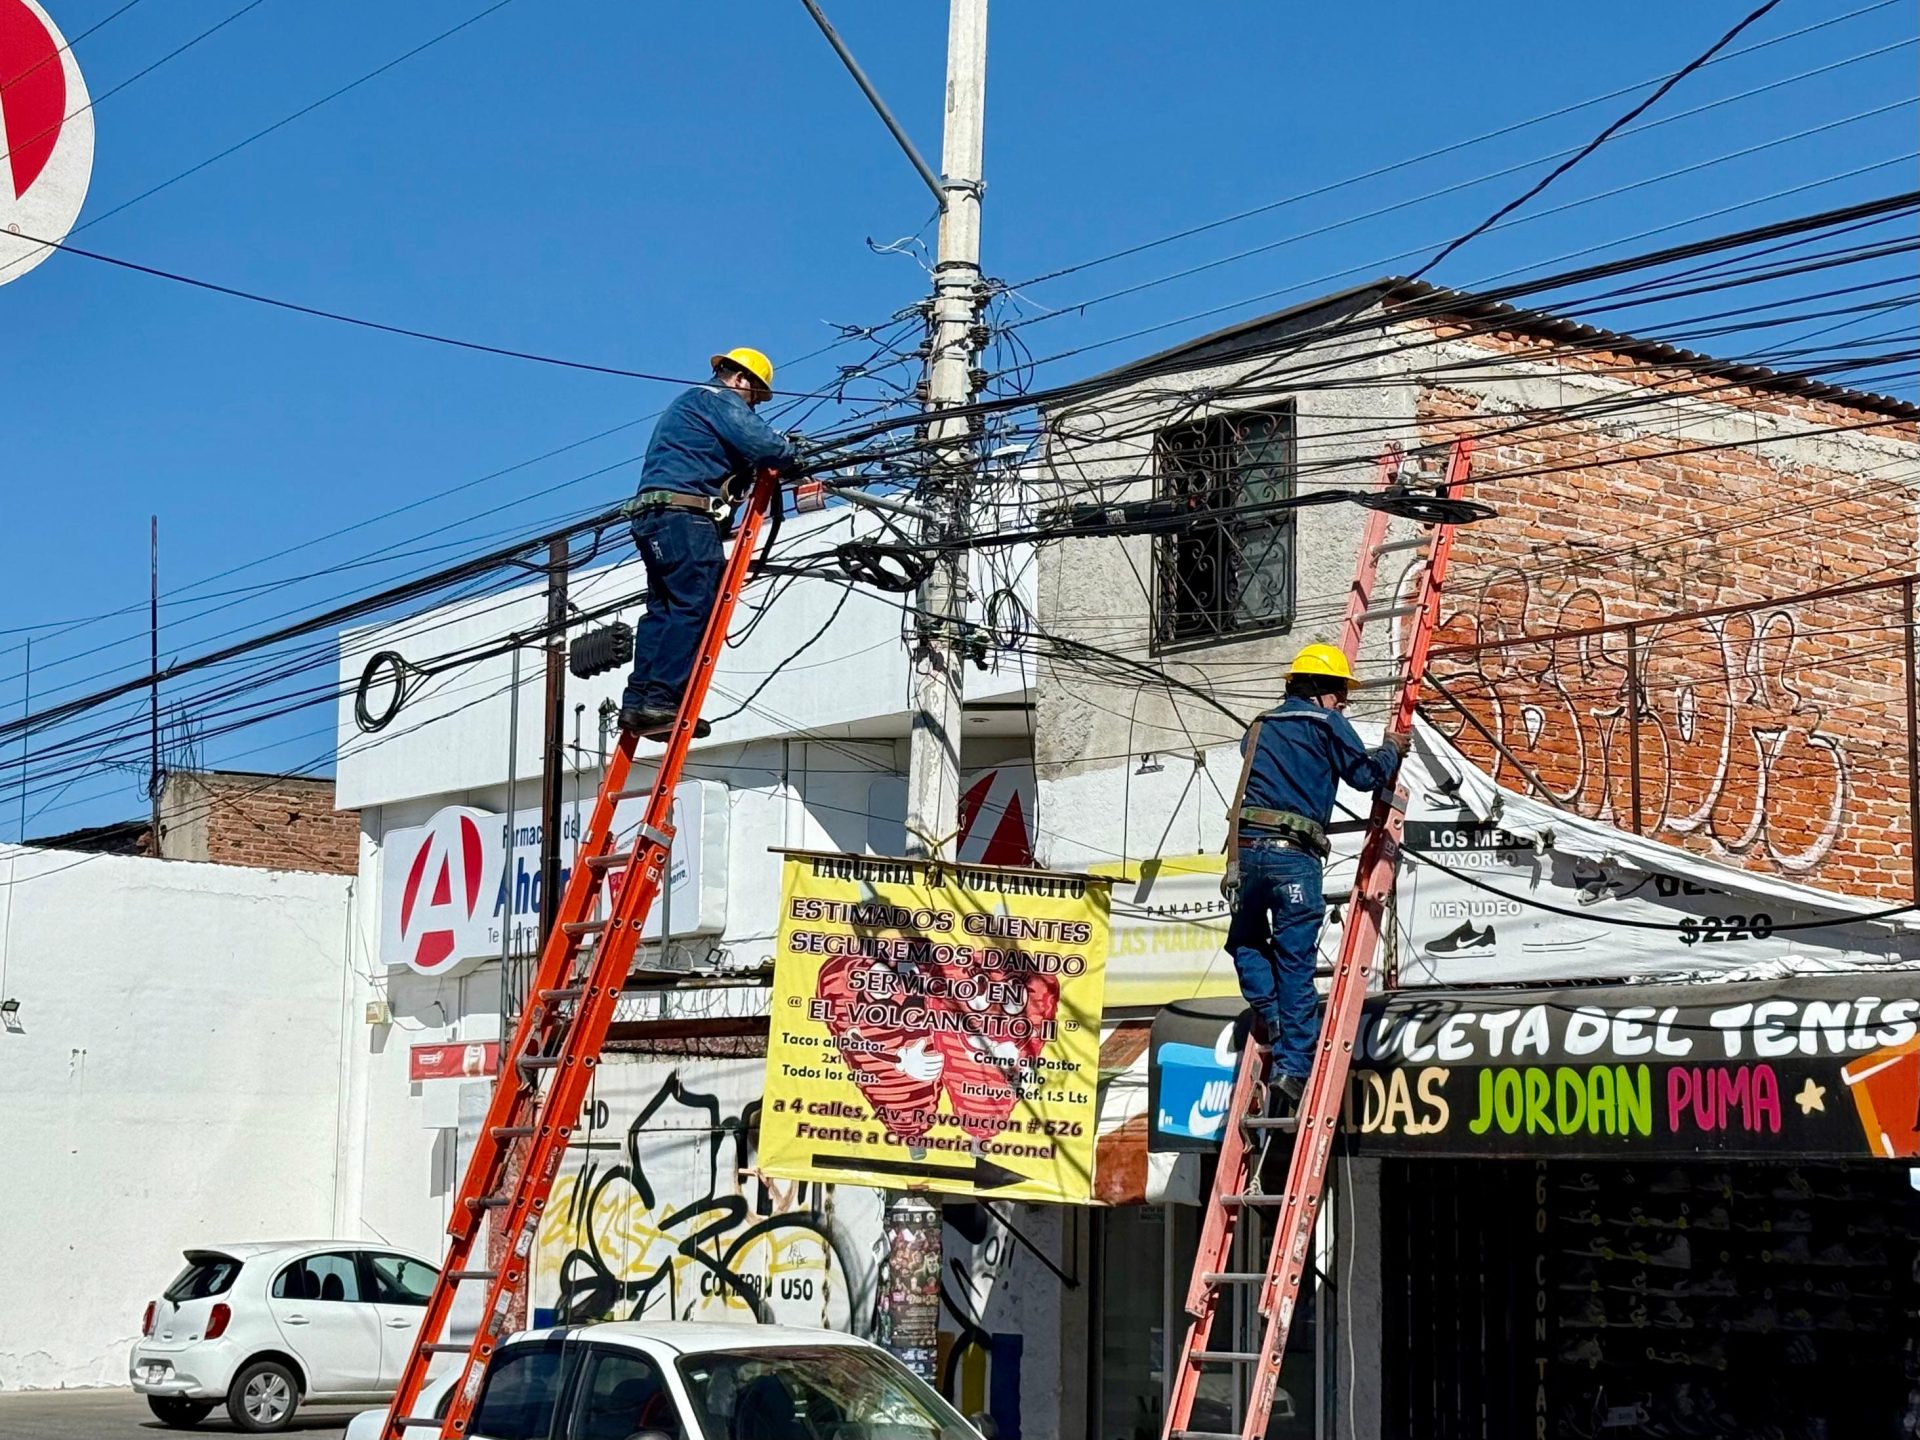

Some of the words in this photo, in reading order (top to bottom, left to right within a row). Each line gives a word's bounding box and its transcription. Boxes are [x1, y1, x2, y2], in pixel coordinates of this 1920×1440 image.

[1430, 830, 1468, 848] LOS
[956, 869, 1086, 899] VOLCANCITO
[790, 897, 955, 931] ESTIMADOS
[963, 914, 1093, 944] CLIENTES
[1147, 900, 1225, 917] PANADER
[1430, 900, 1522, 918] MENUDEO
[1678, 913, 1773, 947] $220
[789, 930, 974, 967] SEGUIREMOS
[981, 947, 1087, 977] DANDO
[849, 970, 979, 1000] SERVICIO
[987, 982, 1025, 1006] EN
[807, 998, 838, 1021] EL
[847, 1002, 1033, 1038] VOLCANCITO
[1563, 1006, 1694, 1058] DEL
[1710, 996, 1919, 1058] TENIS
[782, 1032, 819, 1047] Tacos
[823, 1037, 838, 1048] al
[840, 1038, 886, 1052] Pastor
[782, 1065, 820, 1079] Todos
[825, 1068, 843, 1080] los
[821, 1053, 842, 1064] 2x1
[974, 1053, 1015, 1067] Carne
[1019, 1055, 1034, 1067] al
[1036, 1057, 1082, 1072] Pastor
[962, 1083, 1012, 1100] Incluye
[1047, 1091, 1064, 1102] 1.5
[1069, 1091, 1088, 1104] Lts
[1018, 1072, 1046, 1085] Kilo
[1200, 1080, 1234, 1112] NIK
[1469, 1063, 1652, 1137] JORDAN
[1667, 1064, 1781, 1134] PUMA
[773, 1099, 785, 1113] a
[790, 1098, 803, 1113] 4
[807, 1101, 869, 1121] calles,
[874, 1106, 907, 1122] Av.
[912, 1109, 1023, 1132] Revolucion
[795, 1123, 862, 1142] Frente
[866, 1131, 878, 1144] a
[979, 1139, 1058, 1160] Coronel
[781, 1278, 813, 1301] USO
